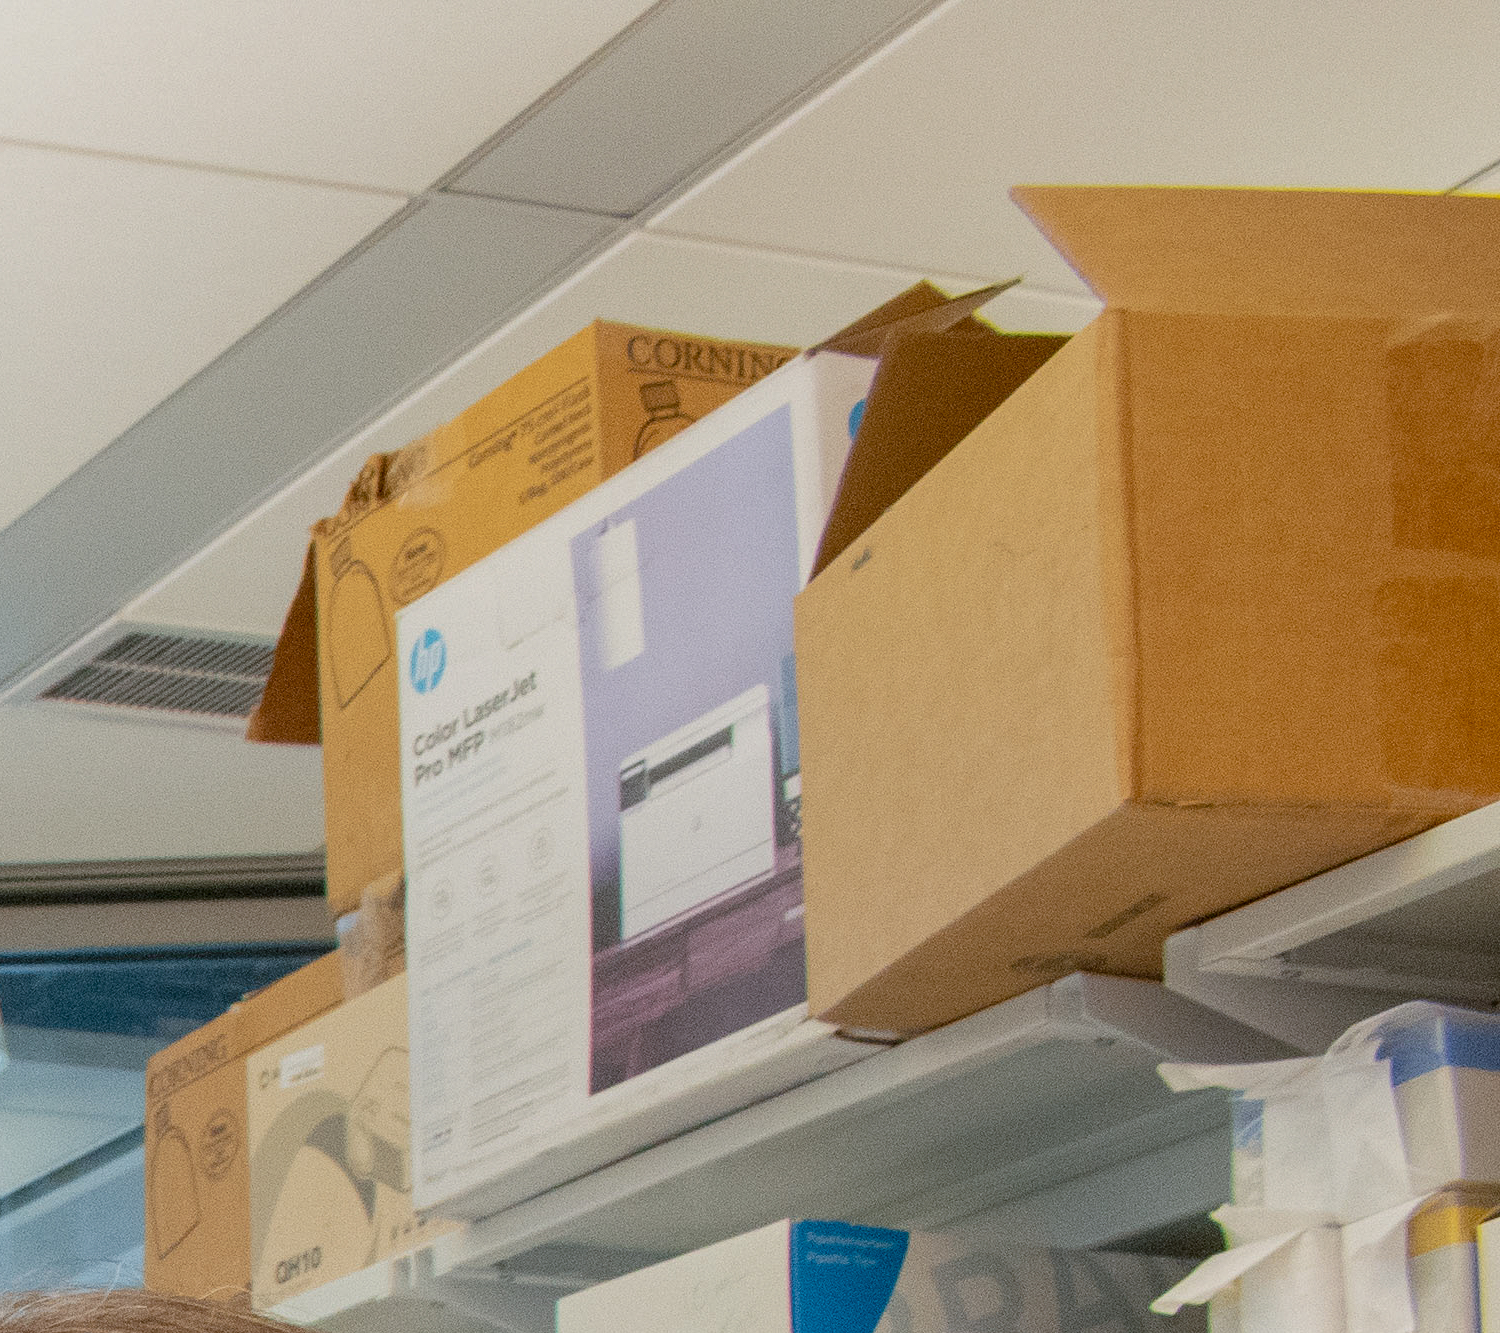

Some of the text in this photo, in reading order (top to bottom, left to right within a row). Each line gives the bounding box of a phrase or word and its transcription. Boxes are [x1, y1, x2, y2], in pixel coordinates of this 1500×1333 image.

[414, 671, 537, 756] Color LaserJet
[414, 759, 444, 787] Pro
[449, 729, 485, 767] MFP
